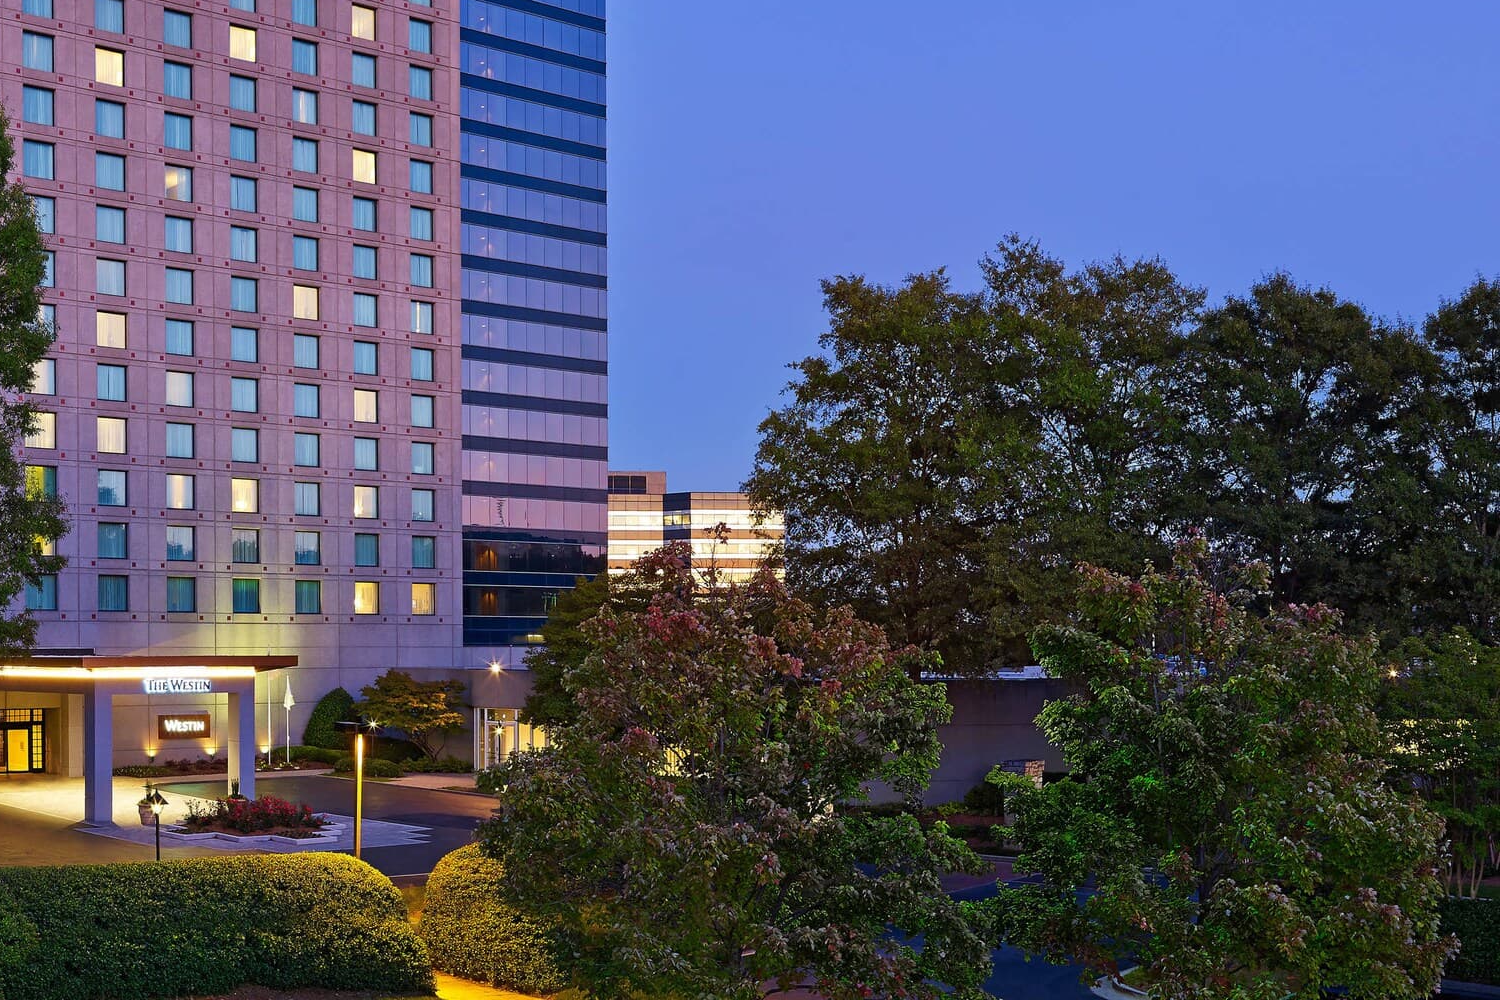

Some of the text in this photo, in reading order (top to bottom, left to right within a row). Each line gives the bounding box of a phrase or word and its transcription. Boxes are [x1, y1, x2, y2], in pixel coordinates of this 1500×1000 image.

[147, 679, 211, 691] THE WESTIN
[164, 719, 205, 732] WESTIN
